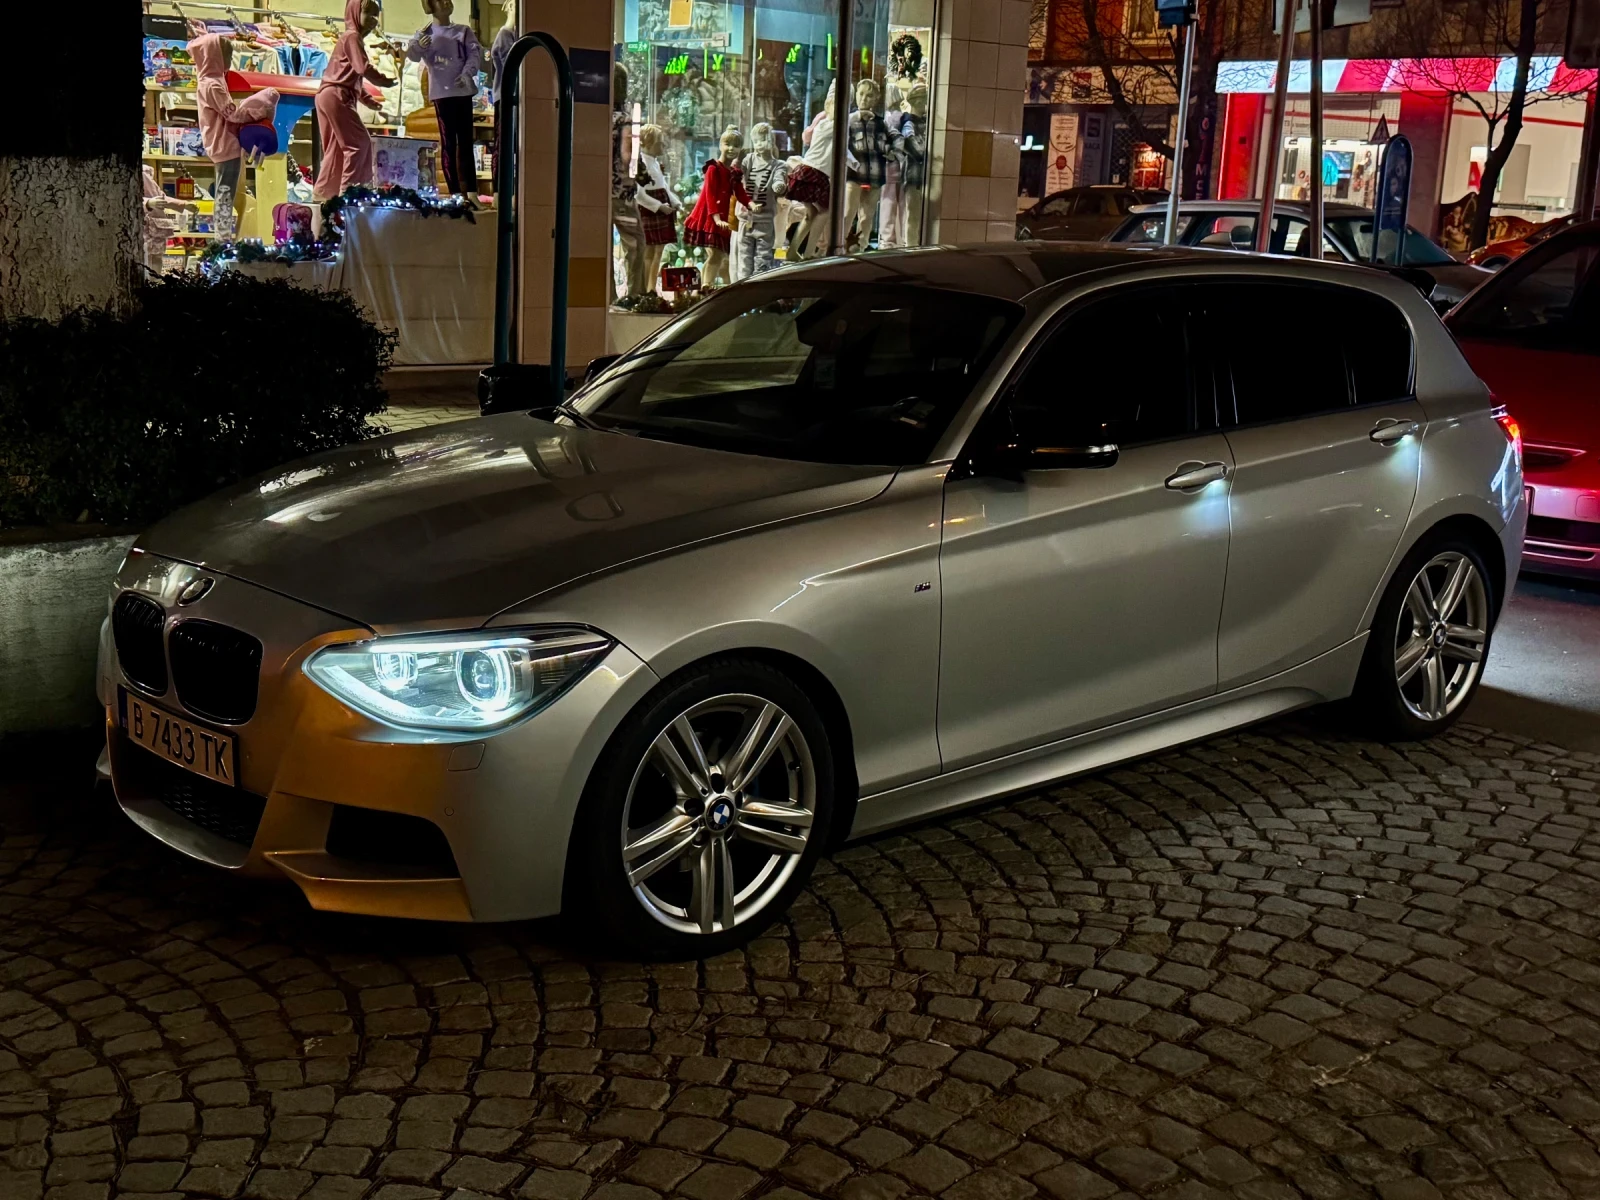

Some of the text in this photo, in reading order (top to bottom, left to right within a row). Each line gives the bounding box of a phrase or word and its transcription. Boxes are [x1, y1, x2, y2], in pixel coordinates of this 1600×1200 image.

[133, 701, 230, 780] B 7433 TK
